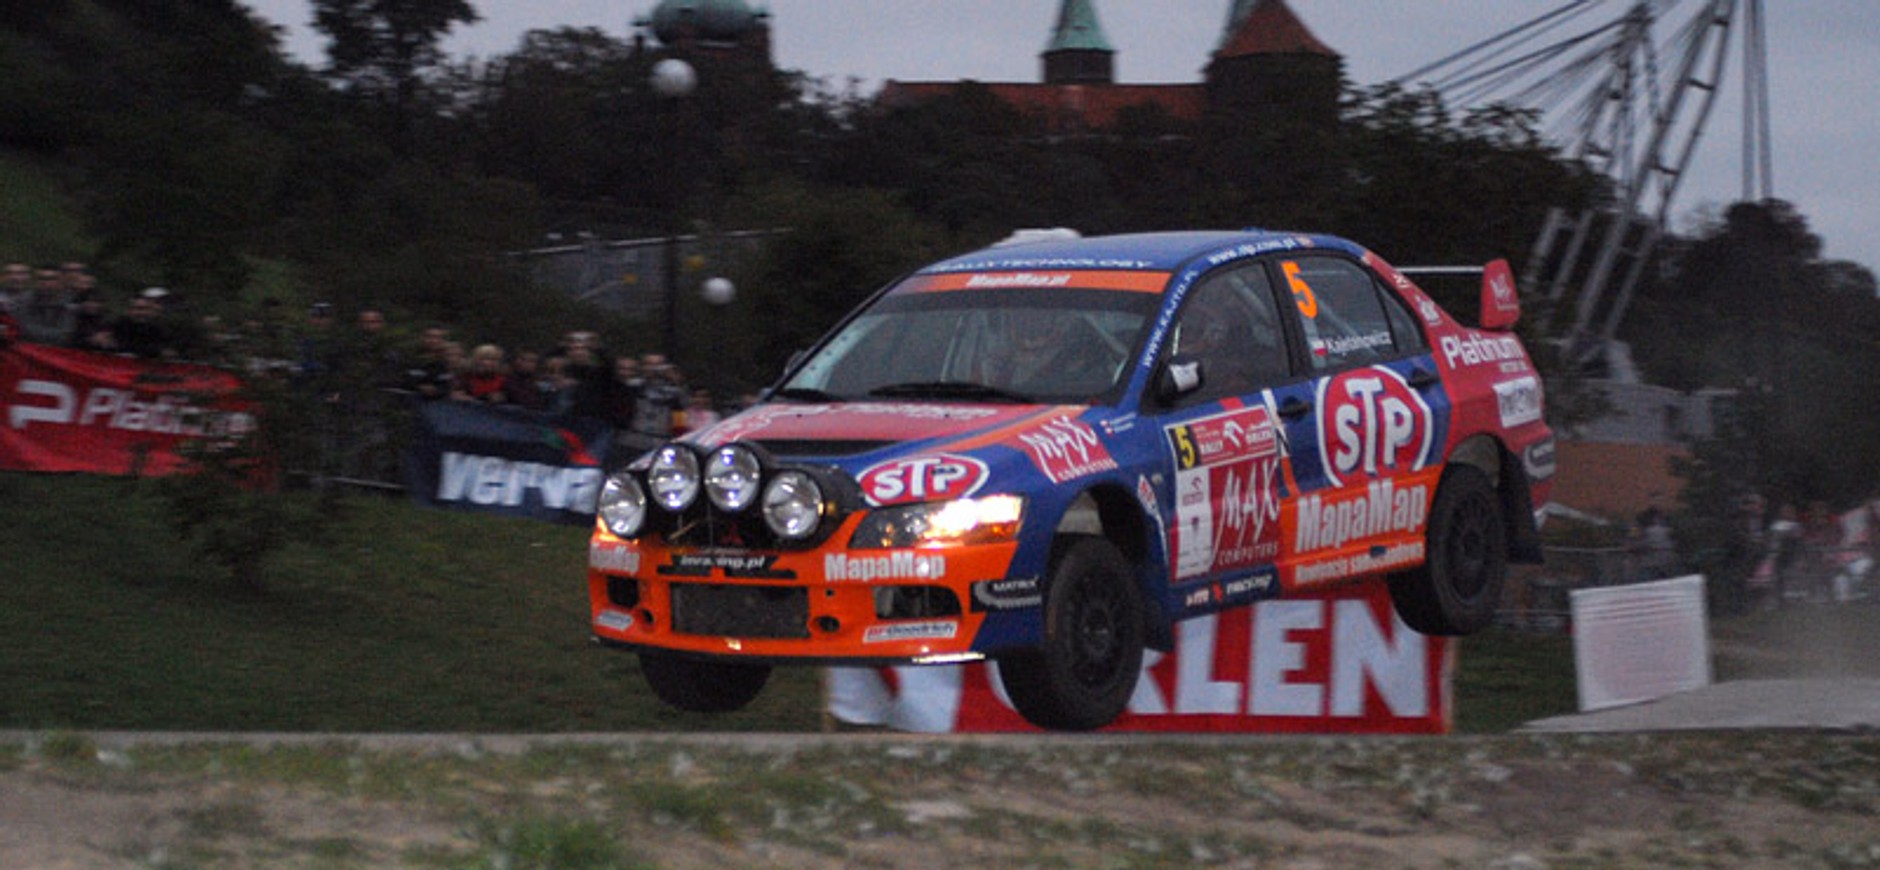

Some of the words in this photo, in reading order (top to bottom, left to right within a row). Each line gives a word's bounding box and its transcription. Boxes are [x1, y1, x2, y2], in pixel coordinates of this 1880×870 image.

[1282, 260, 1318, 319] 5
[1440, 332, 1525, 370] Platinum
[1018, 415, 1098, 484] MAX
[1175, 424, 1196, 469] 5
[1334, 376, 1415, 476] STP
[873, 457, 969, 499] STP
[1213, 458, 1280, 562] MAX
[1295, 478, 1427, 554] MapaMap
[825, 551, 946, 582] MapaMap
